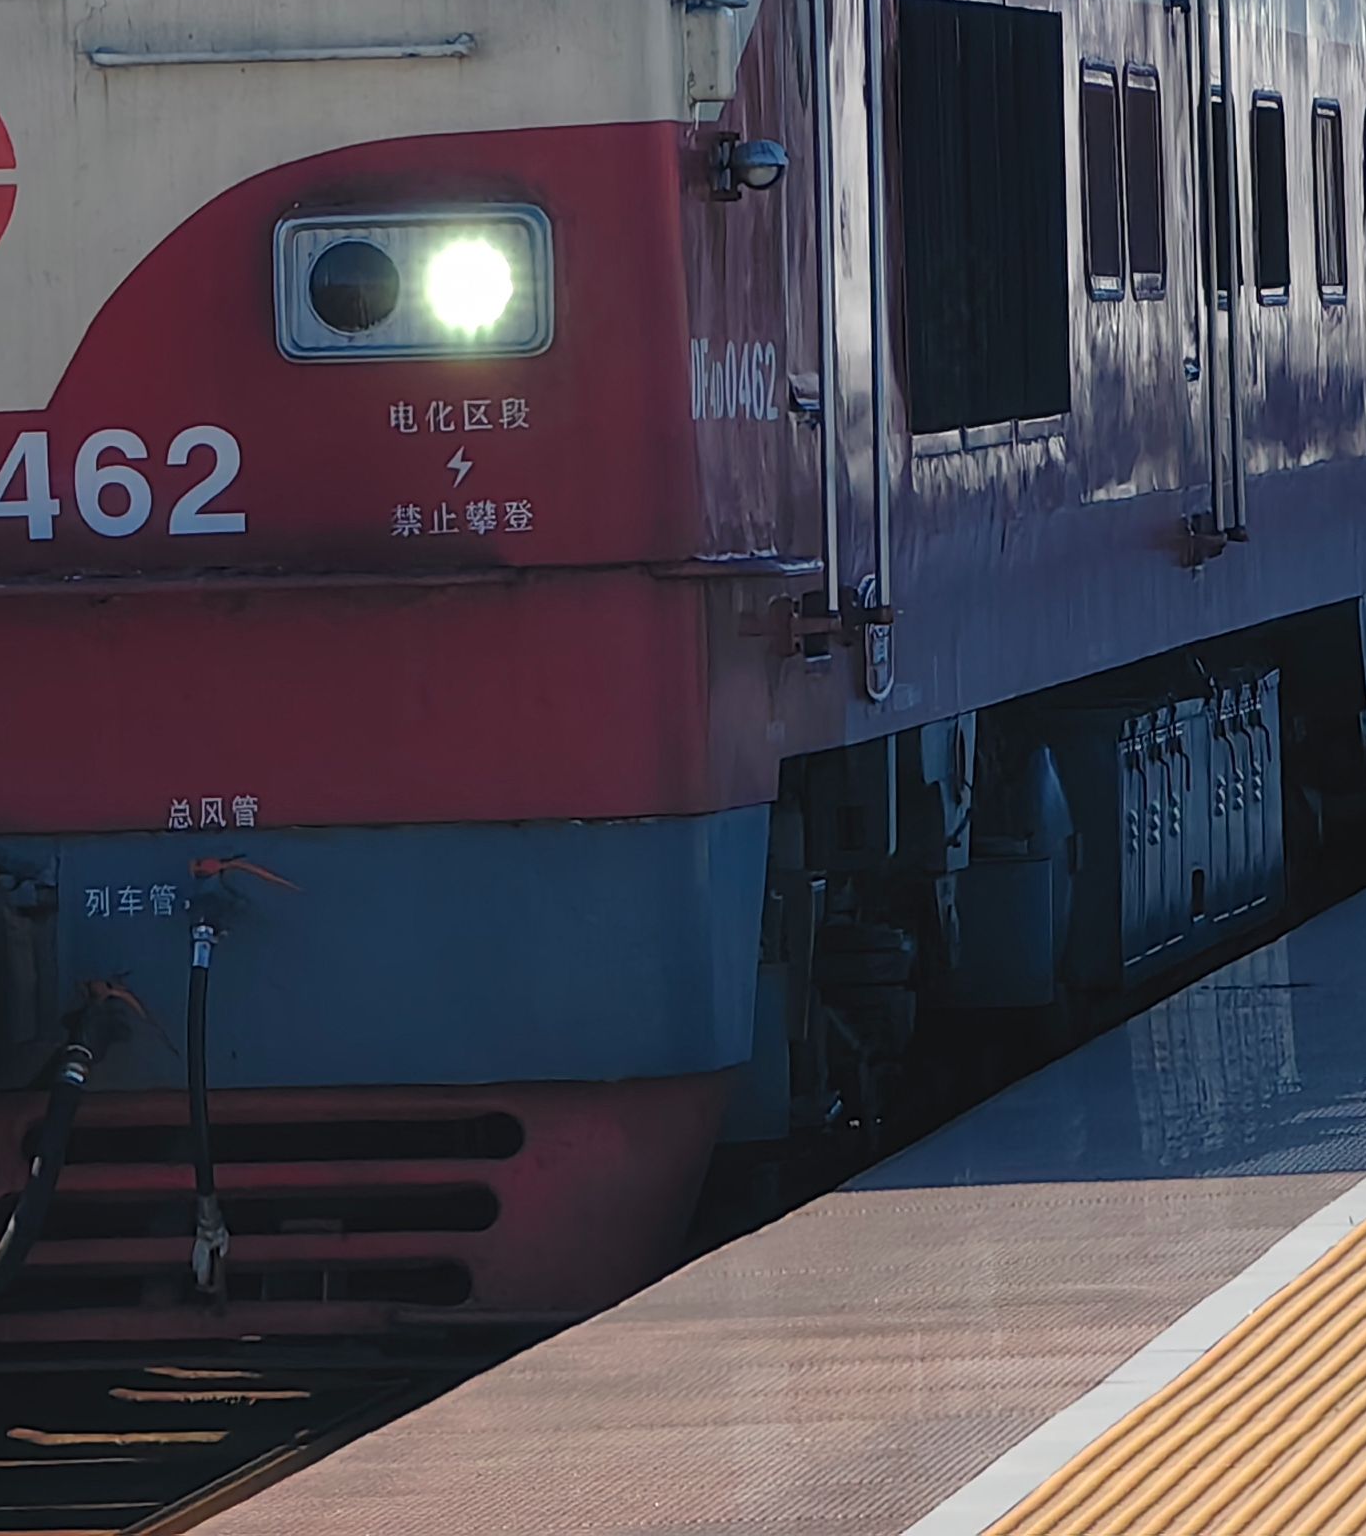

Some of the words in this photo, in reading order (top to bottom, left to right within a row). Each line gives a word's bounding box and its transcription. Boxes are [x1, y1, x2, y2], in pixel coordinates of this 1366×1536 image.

[690, 338, 779, 421] DF4D0462
[389, 397, 531, 434] 电化区段
[391, 500, 533, 538] 禁止攀登
[167, 795, 260, 830] 总风管
[85, 883, 179, 918] 列车管
